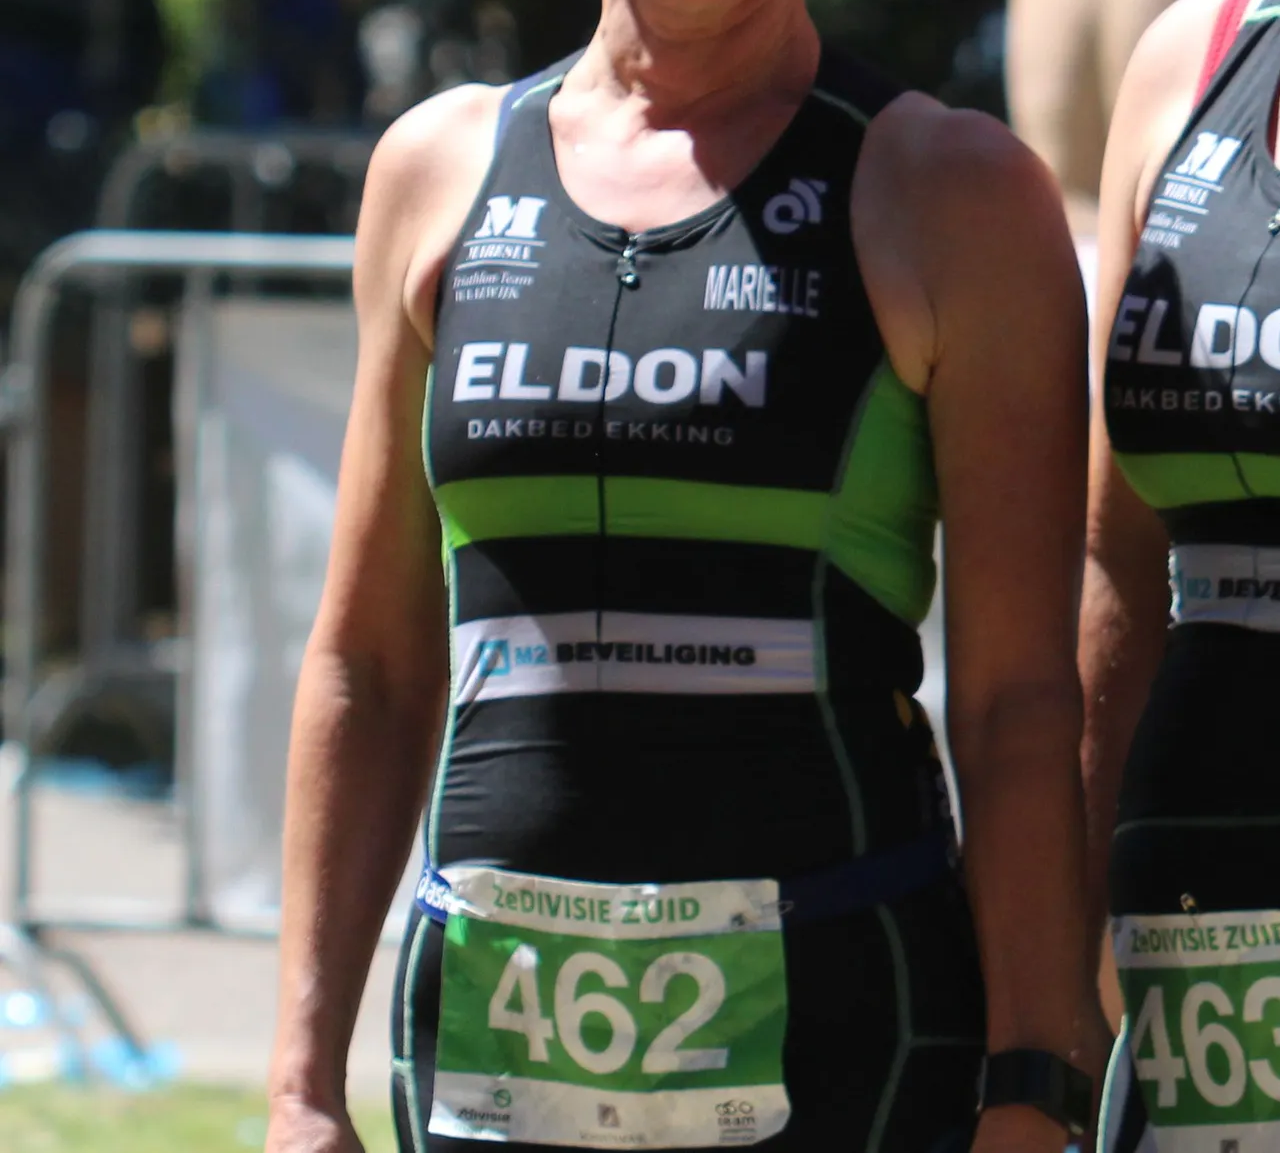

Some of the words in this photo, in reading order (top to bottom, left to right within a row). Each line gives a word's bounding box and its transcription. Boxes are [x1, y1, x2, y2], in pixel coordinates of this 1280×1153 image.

[1175, 132, 1242, 182] M
[475, 196, 547, 238] M
[703, 265, 822, 319] MARIELLE
[452, 341, 769, 409] ELDON
[515, 645, 547, 665] M2
[556, 643, 756, 665] BEVEILIGING
[621, 897, 701, 924] ZUID
[488, 943, 728, 1074] 462
